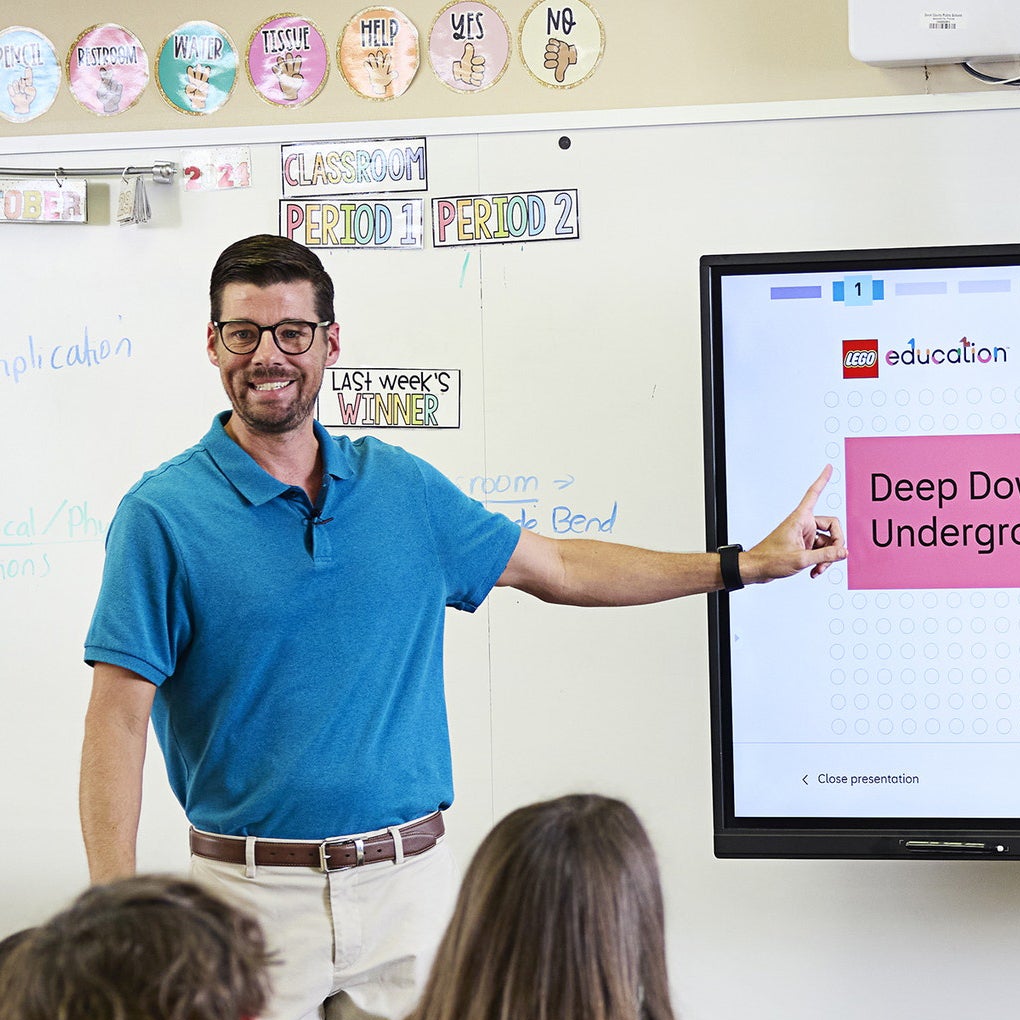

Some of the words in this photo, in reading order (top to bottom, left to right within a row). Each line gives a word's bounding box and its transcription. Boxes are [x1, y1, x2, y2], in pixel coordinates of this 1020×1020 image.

[361, 19, 399, 48] HELP
[451, 12, 484, 40] YES
[547, 7, 577, 35] NO
[174, 35, 223, 60] WATER
[262, 27, 310, 53] TISSUE
[78, 46, 138, 66] RESTROOM
[284, 146, 425, 187] CLASSROOM
[0, 190, 82, 220] OBER
[437, 195, 546, 242] PERIOD
[554, 192, 574, 235] 2
[286, 203, 393, 246] PERIOD
[400, 203, 417, 246] 1
[854, 281, 862, 297] 1
[844, 350, 877, 368] LEGO
[885, 336, 1008, 366] education
[337, 392, 440, 426] WINNER
[871, 472, 958, 509] Deep
[552, 501, 618, 535] Bend
[817, 772, 848, 785] Close
[851, 772, 919, 788] presentation
